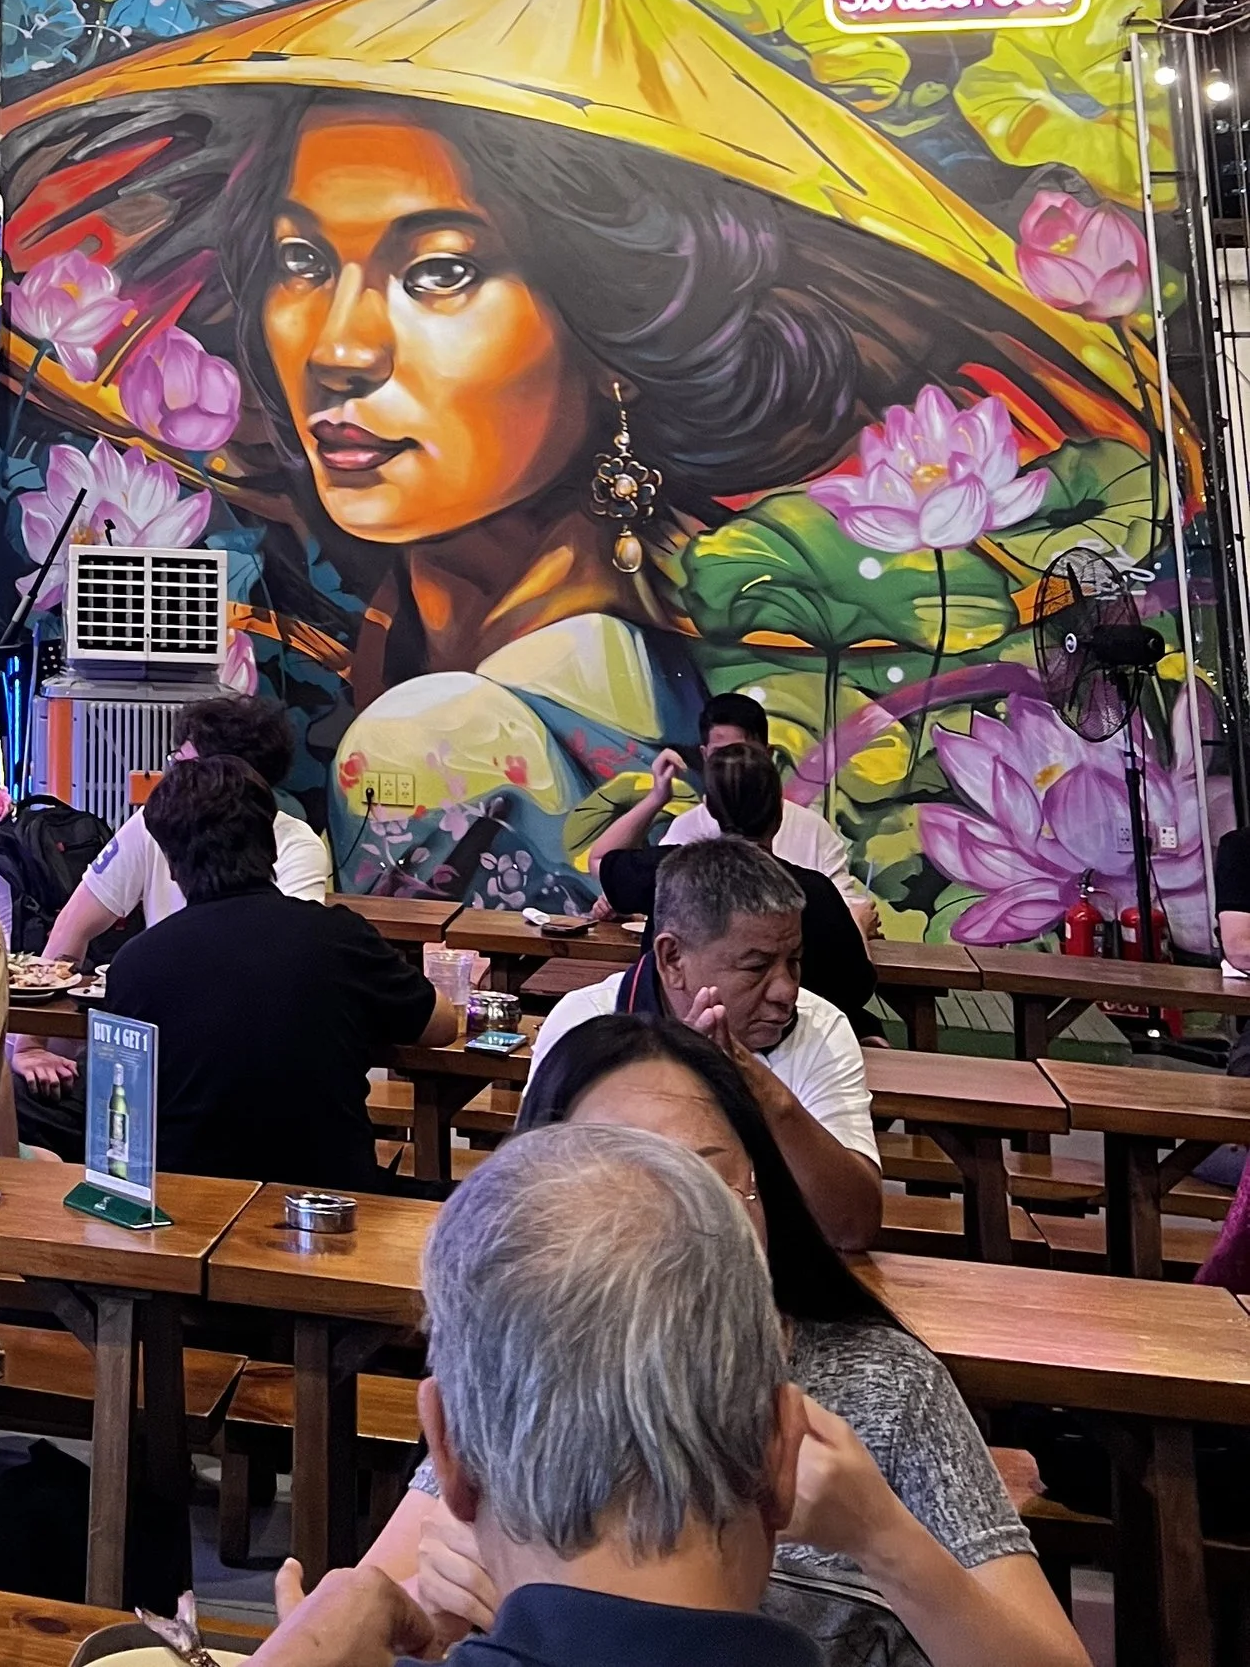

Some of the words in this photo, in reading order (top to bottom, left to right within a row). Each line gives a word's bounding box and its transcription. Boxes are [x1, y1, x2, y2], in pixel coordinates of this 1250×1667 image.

[93, 1021, 111, 1044] BUY
[113, 1027, 121, 1046] 4
[122, 1028, 140, 1049] GET
